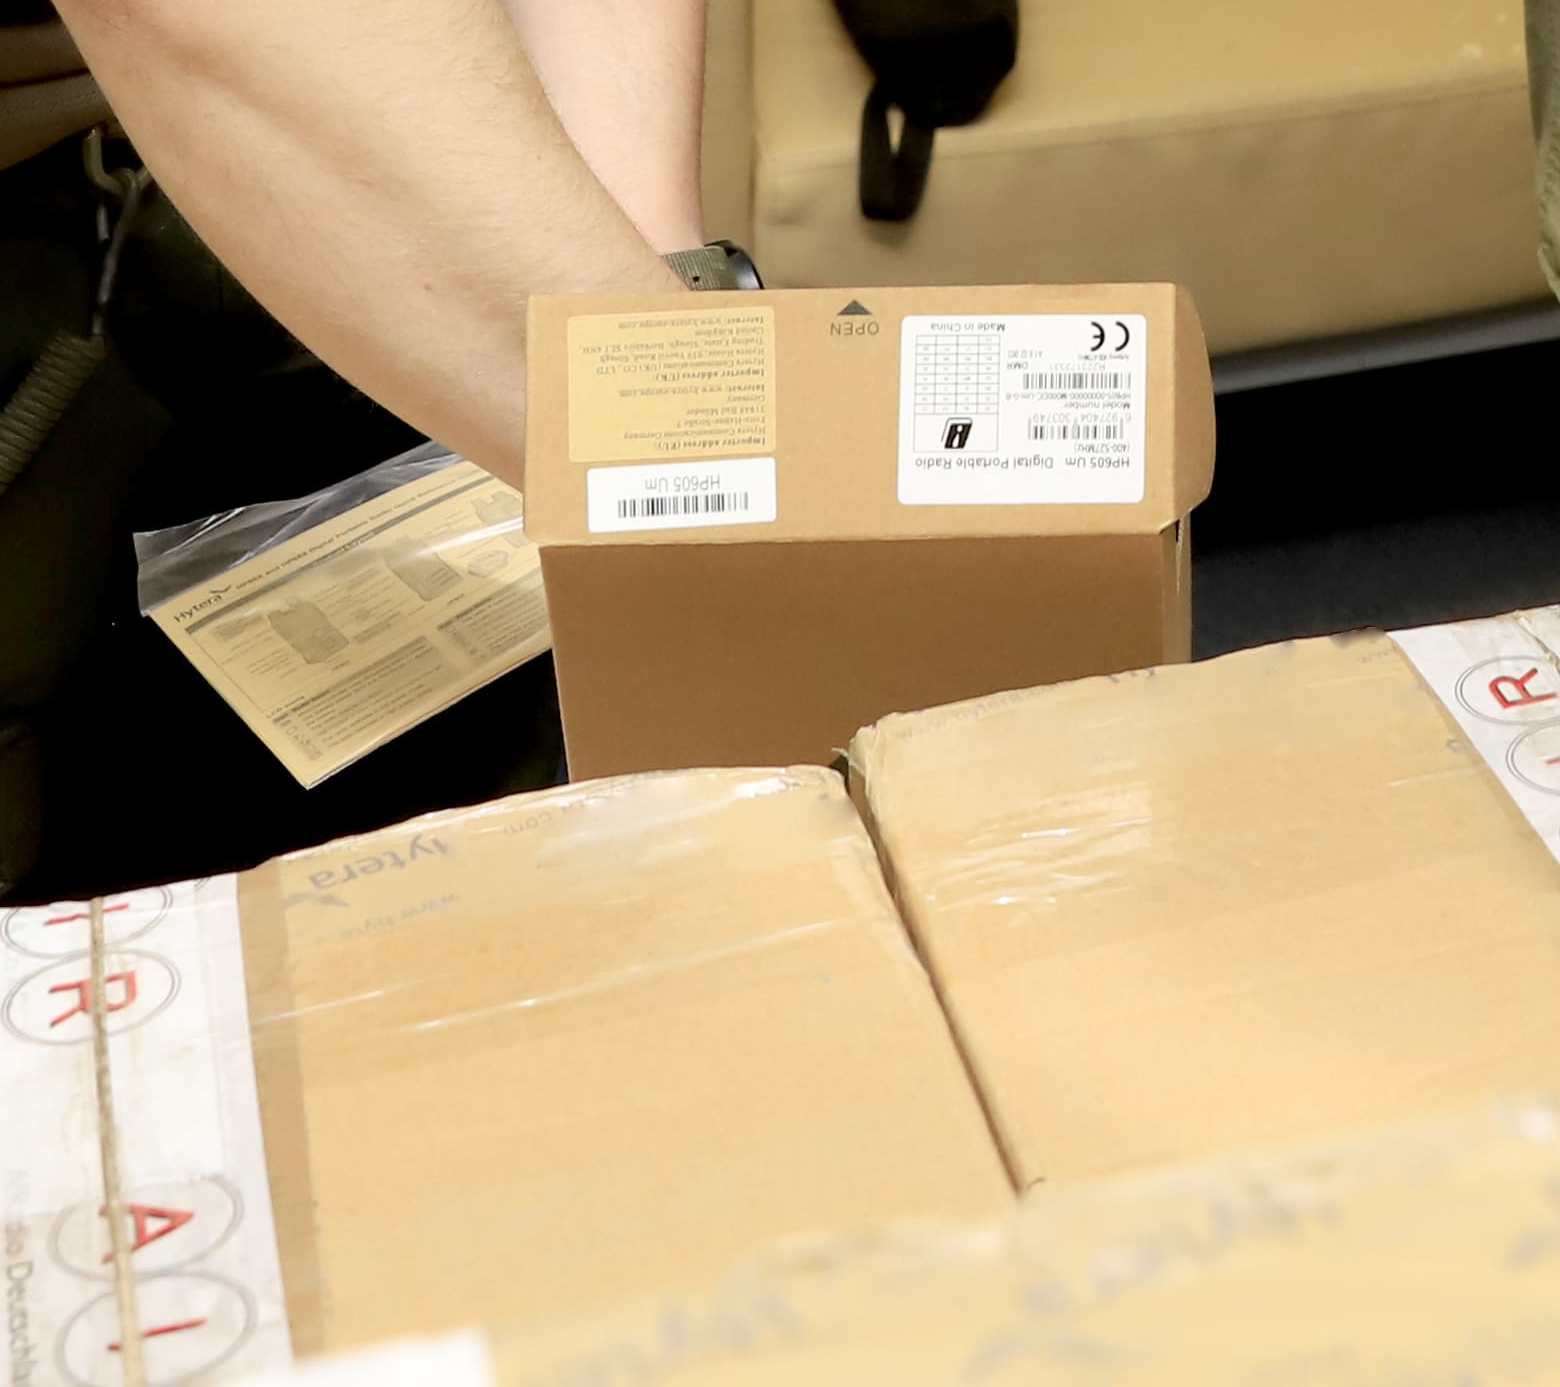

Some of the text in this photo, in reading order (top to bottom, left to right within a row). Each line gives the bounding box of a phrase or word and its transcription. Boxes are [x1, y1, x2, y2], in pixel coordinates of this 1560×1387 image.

[830, 321, 880, 336] OPEN
[930, 322, 1006, 332] Made in China
[721, 368, 765, 377] Importer
[683, 440, 719, 449] address
[723, 436, 766, 446] Importer
[914, 455, 1130, 470] HP605 Um Digital Portable Radio
[644, 474, 720, 492] HP605 Um
[173, 594, 223, 623] Hytera
